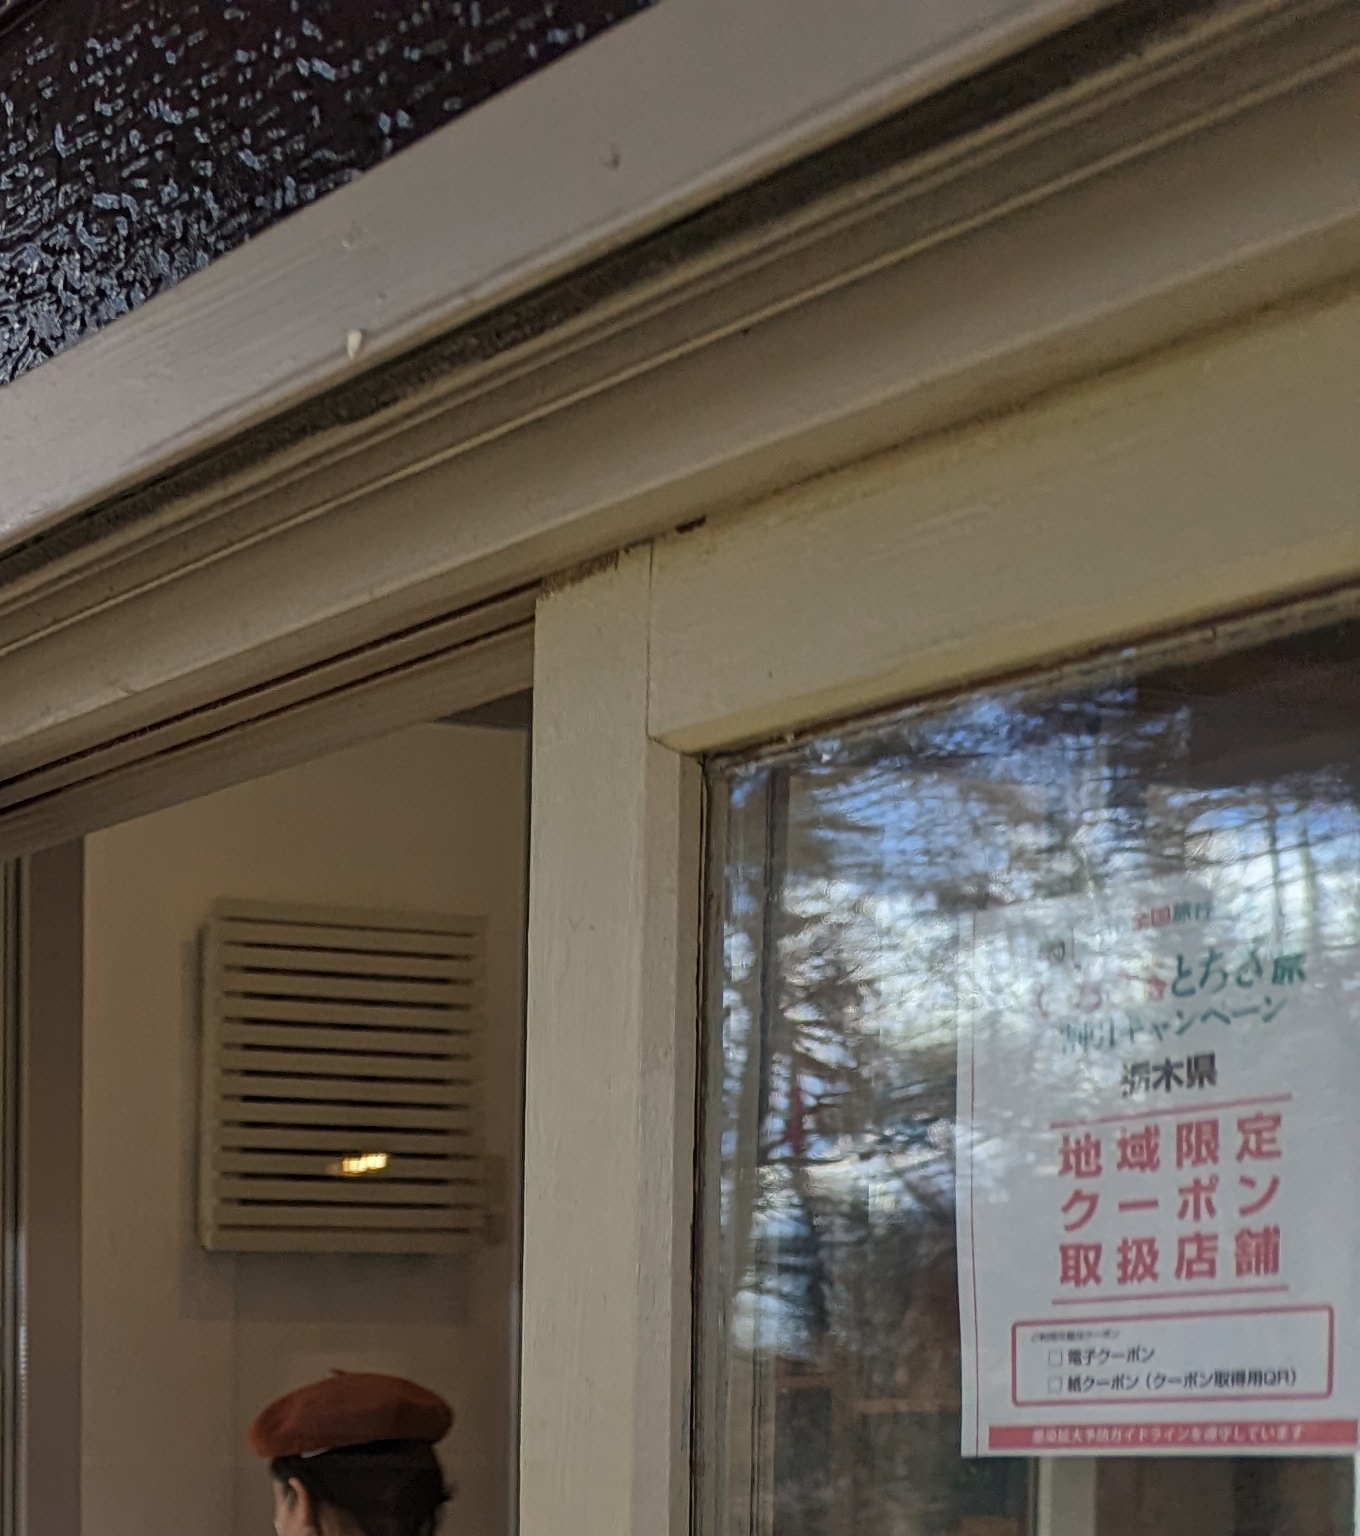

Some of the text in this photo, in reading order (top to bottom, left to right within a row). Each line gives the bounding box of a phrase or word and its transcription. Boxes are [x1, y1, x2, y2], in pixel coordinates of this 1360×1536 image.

[1120, 1053, 1218, 1098] 栃木県
[1058, 1112, 1283, 1178] 地域限定
[1061, 1174, 1281, 1232] クーポン
[1057, 1224, 1281, 1288] 取扱店舗
[1067, 1344, 1155, 1367] 電子クーポン
